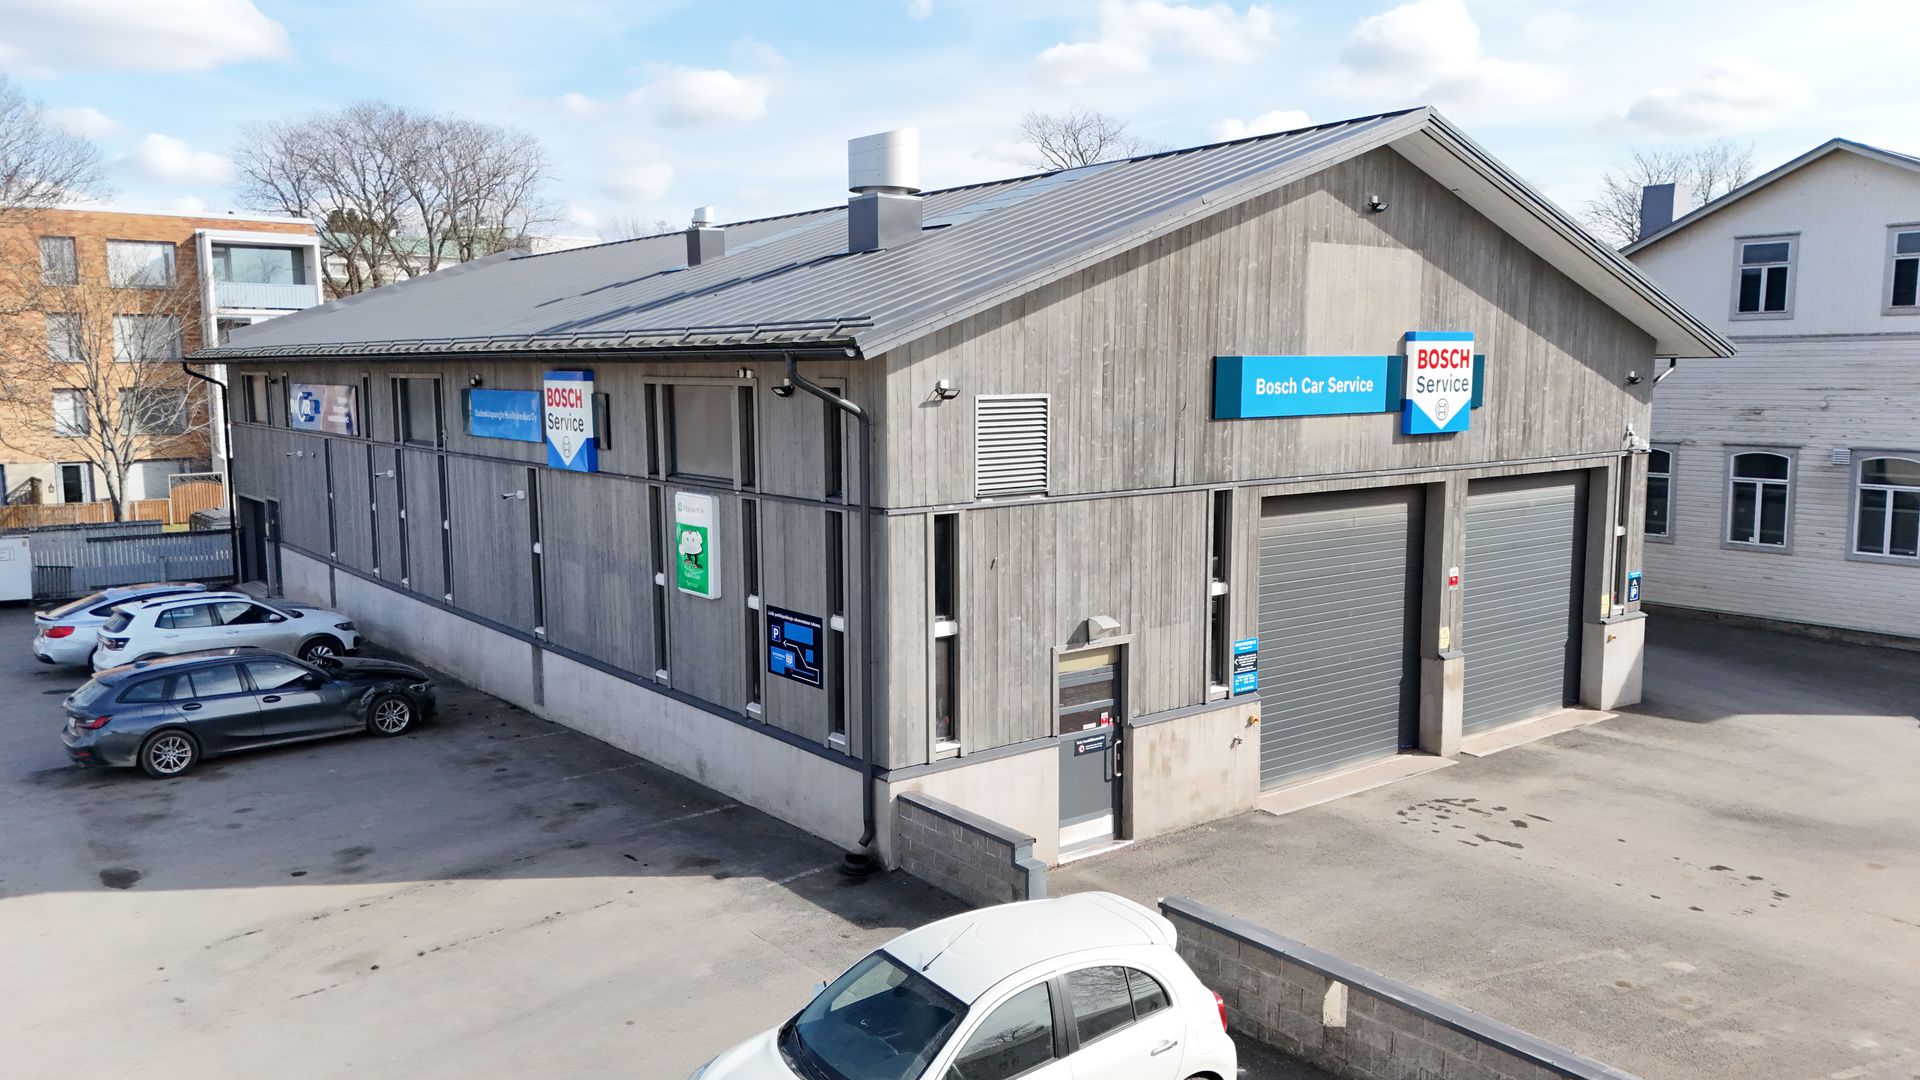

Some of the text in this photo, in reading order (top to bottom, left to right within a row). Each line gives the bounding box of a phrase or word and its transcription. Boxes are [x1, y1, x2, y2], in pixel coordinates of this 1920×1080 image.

[1417, 348, 1470, 370] BOSCH
[1256, 376, 1374, 396] Bosch Car Service
[1416, 373, 1469, 394] Service
[546, 387, 583, 409] BOSCH
[547, 412, 584, 432] Service
